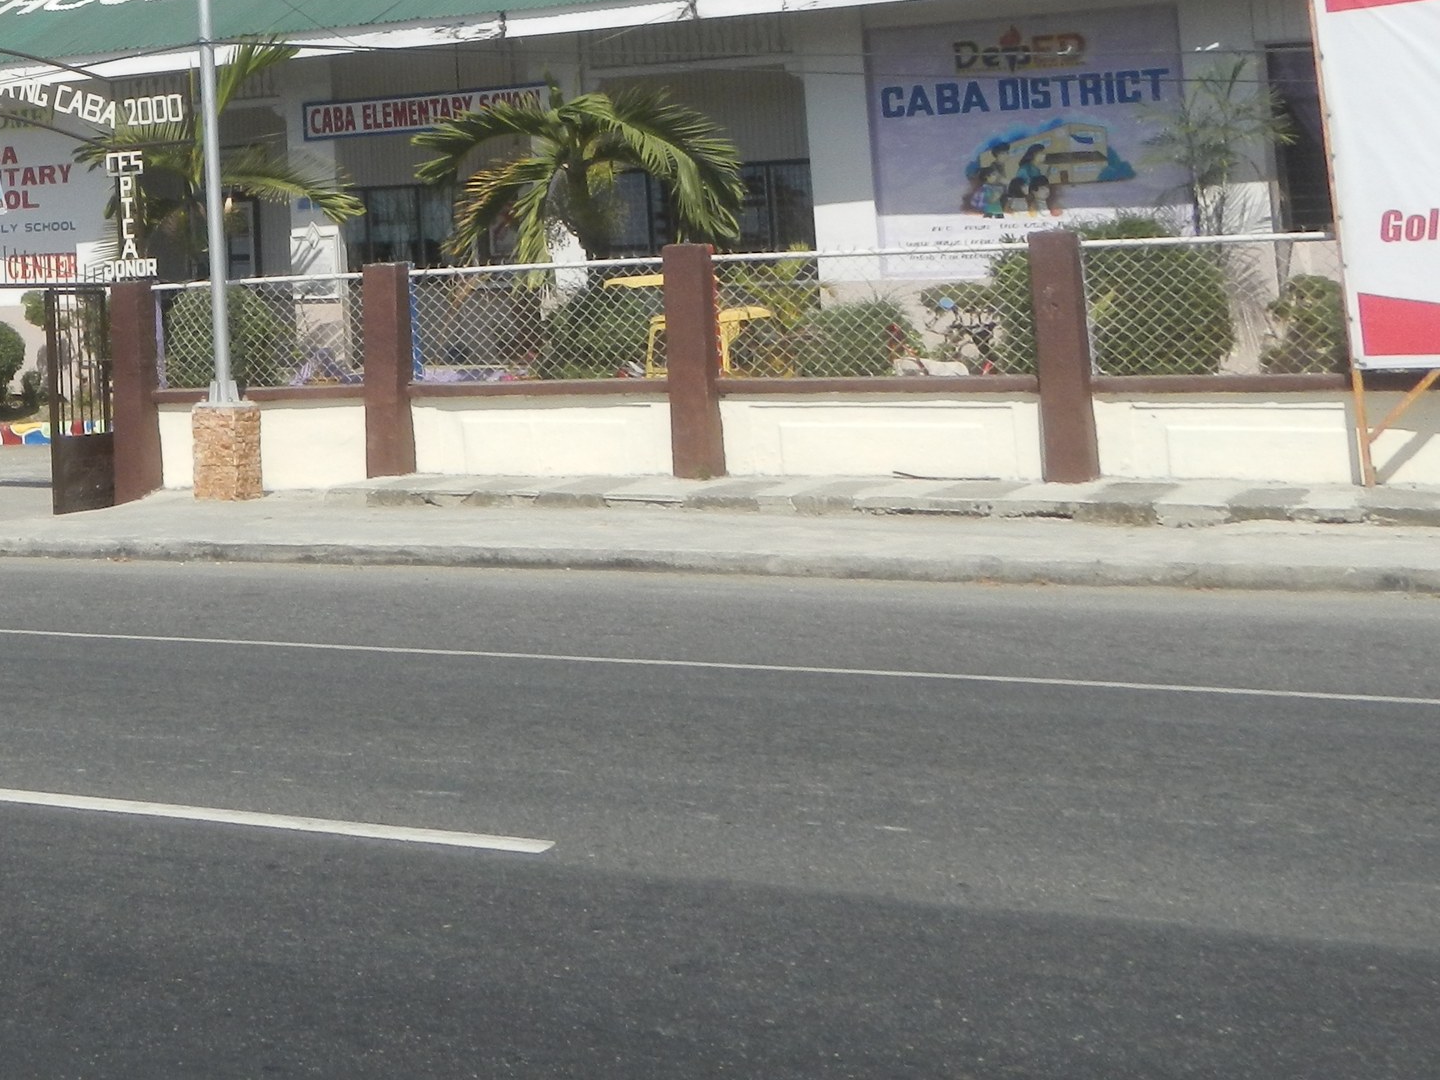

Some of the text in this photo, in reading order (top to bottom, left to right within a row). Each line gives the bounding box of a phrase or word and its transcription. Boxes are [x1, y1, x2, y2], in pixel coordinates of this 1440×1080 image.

[53, 85, 116, 128] CABA
[124, 94, 183, 126] 2000
[881, 67, 1171, 119] CABA DISTRICT
[311, 105, 356, 134] CABA
[362, 96, 473, 130] ELEMENTARY
[24, 221, 76, 233] SCHOOL
[7, 251, 78, 280] CENTER
